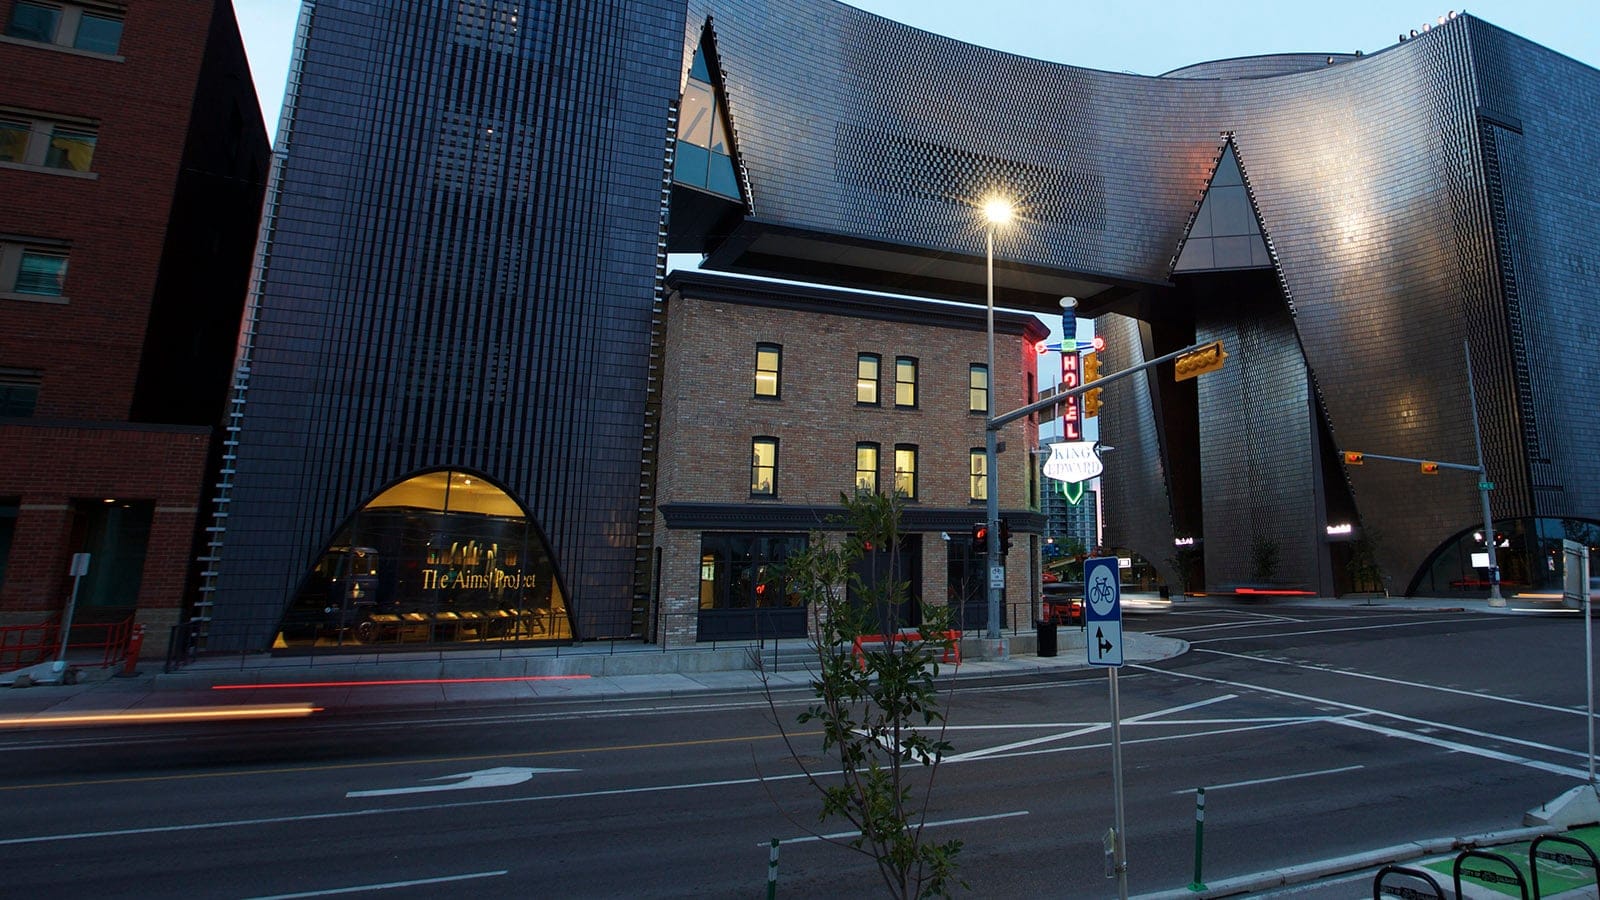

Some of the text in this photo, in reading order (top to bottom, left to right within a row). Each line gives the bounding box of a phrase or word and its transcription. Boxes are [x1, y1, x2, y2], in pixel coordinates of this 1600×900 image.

[1063, 356, 1078, 438] HOEL
[1055, 447, 1091, 460] KING
[1047, 461, 1100, 476] EDWARD
[452, 569, 489, 589] Aims
